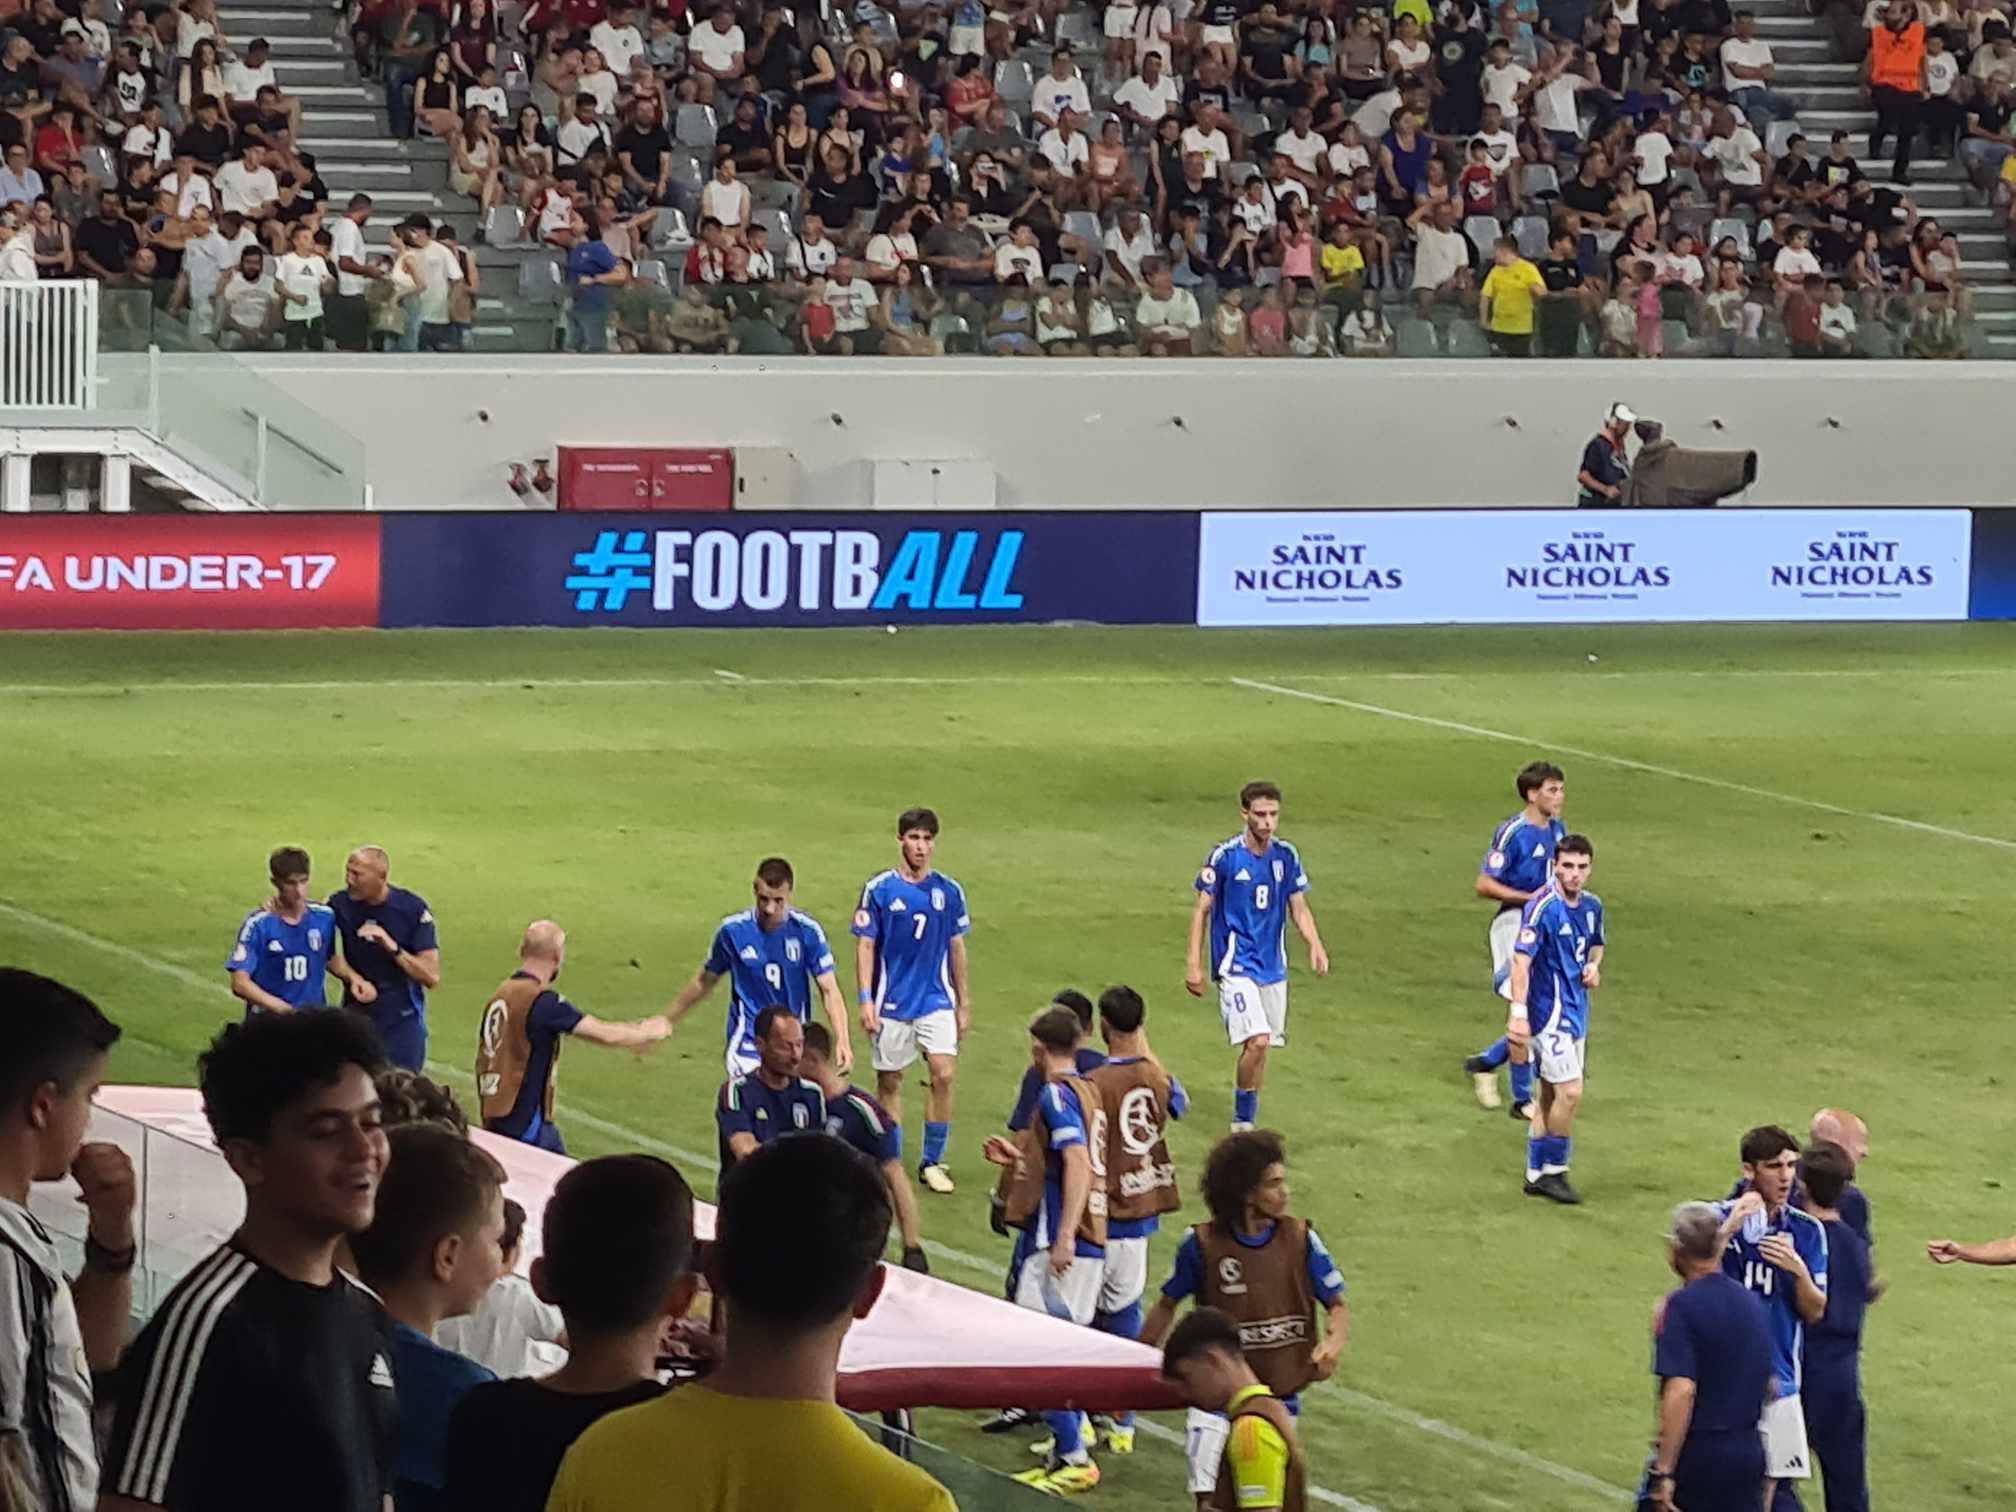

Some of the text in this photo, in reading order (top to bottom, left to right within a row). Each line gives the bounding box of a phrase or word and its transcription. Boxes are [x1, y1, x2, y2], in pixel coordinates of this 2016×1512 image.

[1272, 544, 1366, 565] SAINT
[1543, 542, 1636, 563] SAINT
[1808, 541, 1899, 561] SAINT
[65, 555, 336, 591] UNDER-17
[566, 531, 1024, 611] #FOOTBALL
[1234, 568, 1403, 590] NICHOLAS
[1506, 566, 1671, 588] NICHOLAS
[1771, 565, 1934, 586] NICHOLAS
[1255, 884, 1268, 909] 8
[912, 913, 927, 940] 7
[1576, 936, 1586, 963] 2
[284, 955, 308, 981] 10
[764, 963, 780, 990] 9
[1234, 991, 1247, 1013] 8
[1549, 1034, 1564, 1056] 2
[1744, 1260, 1773, 1295] 14
